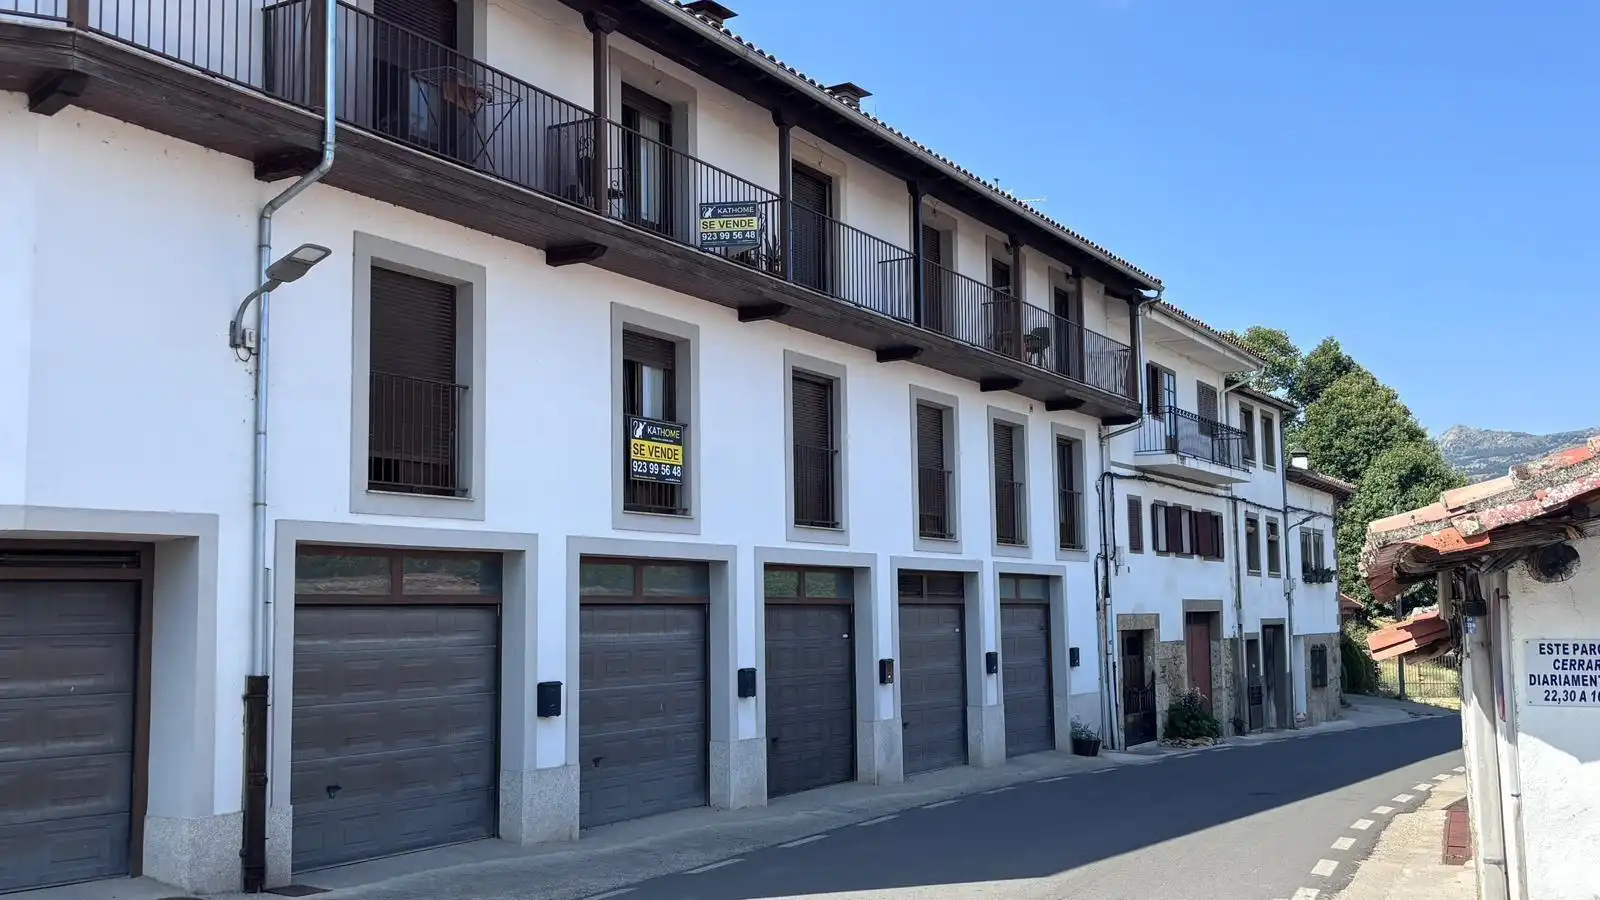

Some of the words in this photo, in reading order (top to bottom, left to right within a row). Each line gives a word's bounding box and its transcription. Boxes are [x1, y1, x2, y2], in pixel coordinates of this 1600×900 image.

[717, 206, 754, 214] KATHOME
[702, 220, 716, 229] SE
[718, 219, 754, 228] VENDE
[702, 232, 717, 240] 923
[732, 231, 743, 239] 56
[647, 425, 680, 439] KATHOME
[633, 443, 645, 456] SE
[648, 445, 679, 460] VENDE
[633, 460, 647, 473] 923
[649, 463, 659, 474] 99
[661, 464, 671, 475] 56
[672, 465, 681, 477] 48
[1538, 643, 1570, 655] ESTE
[1544, 689, 1576, 704] 22,30
[1579, 690, 1587, 703] A
